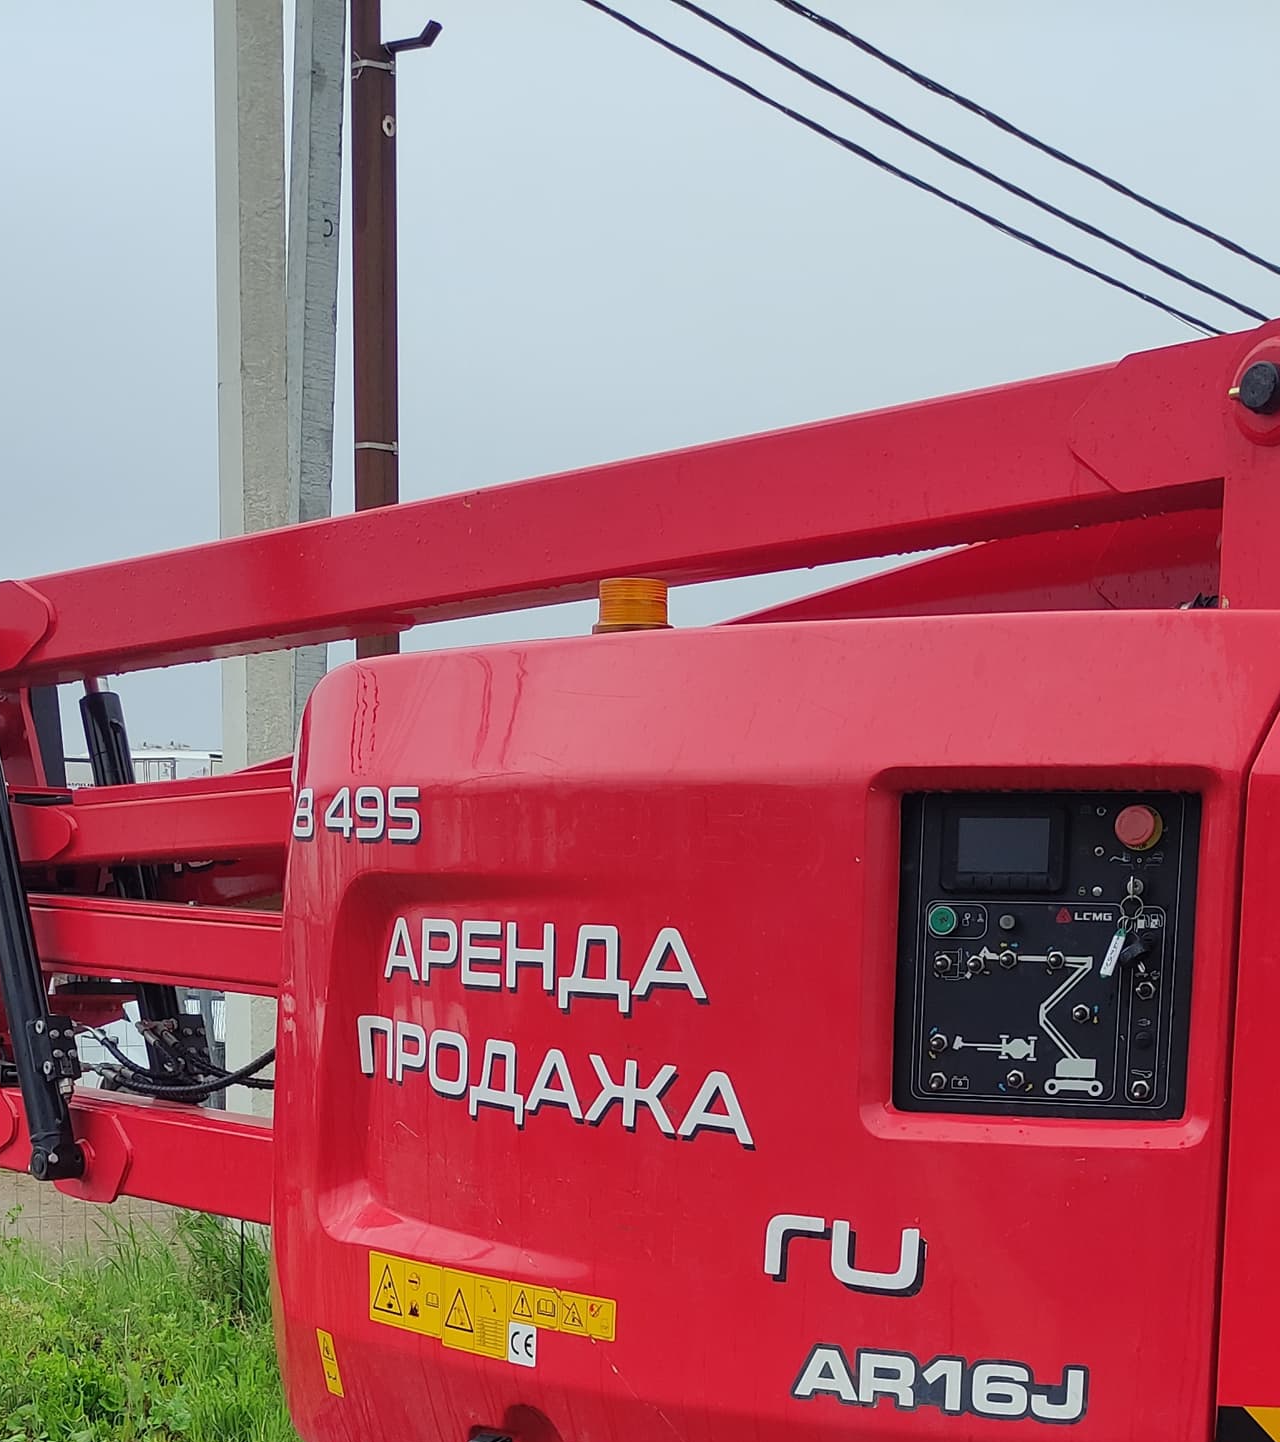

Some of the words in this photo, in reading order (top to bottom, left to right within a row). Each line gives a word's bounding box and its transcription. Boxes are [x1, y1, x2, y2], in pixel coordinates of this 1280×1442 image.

[292, 787, 314, 841] 8
[324, 786, 421, 843] 495
[383, 917, 709, 1018] АРЕНДА
[356, 1014, 757, 1151] ПРОДАЖА
[764, 1213, 927, 1297] ru
[510, 1331, 533, 1358] CE
[792, 1344, 1089, 1424] AR16J
